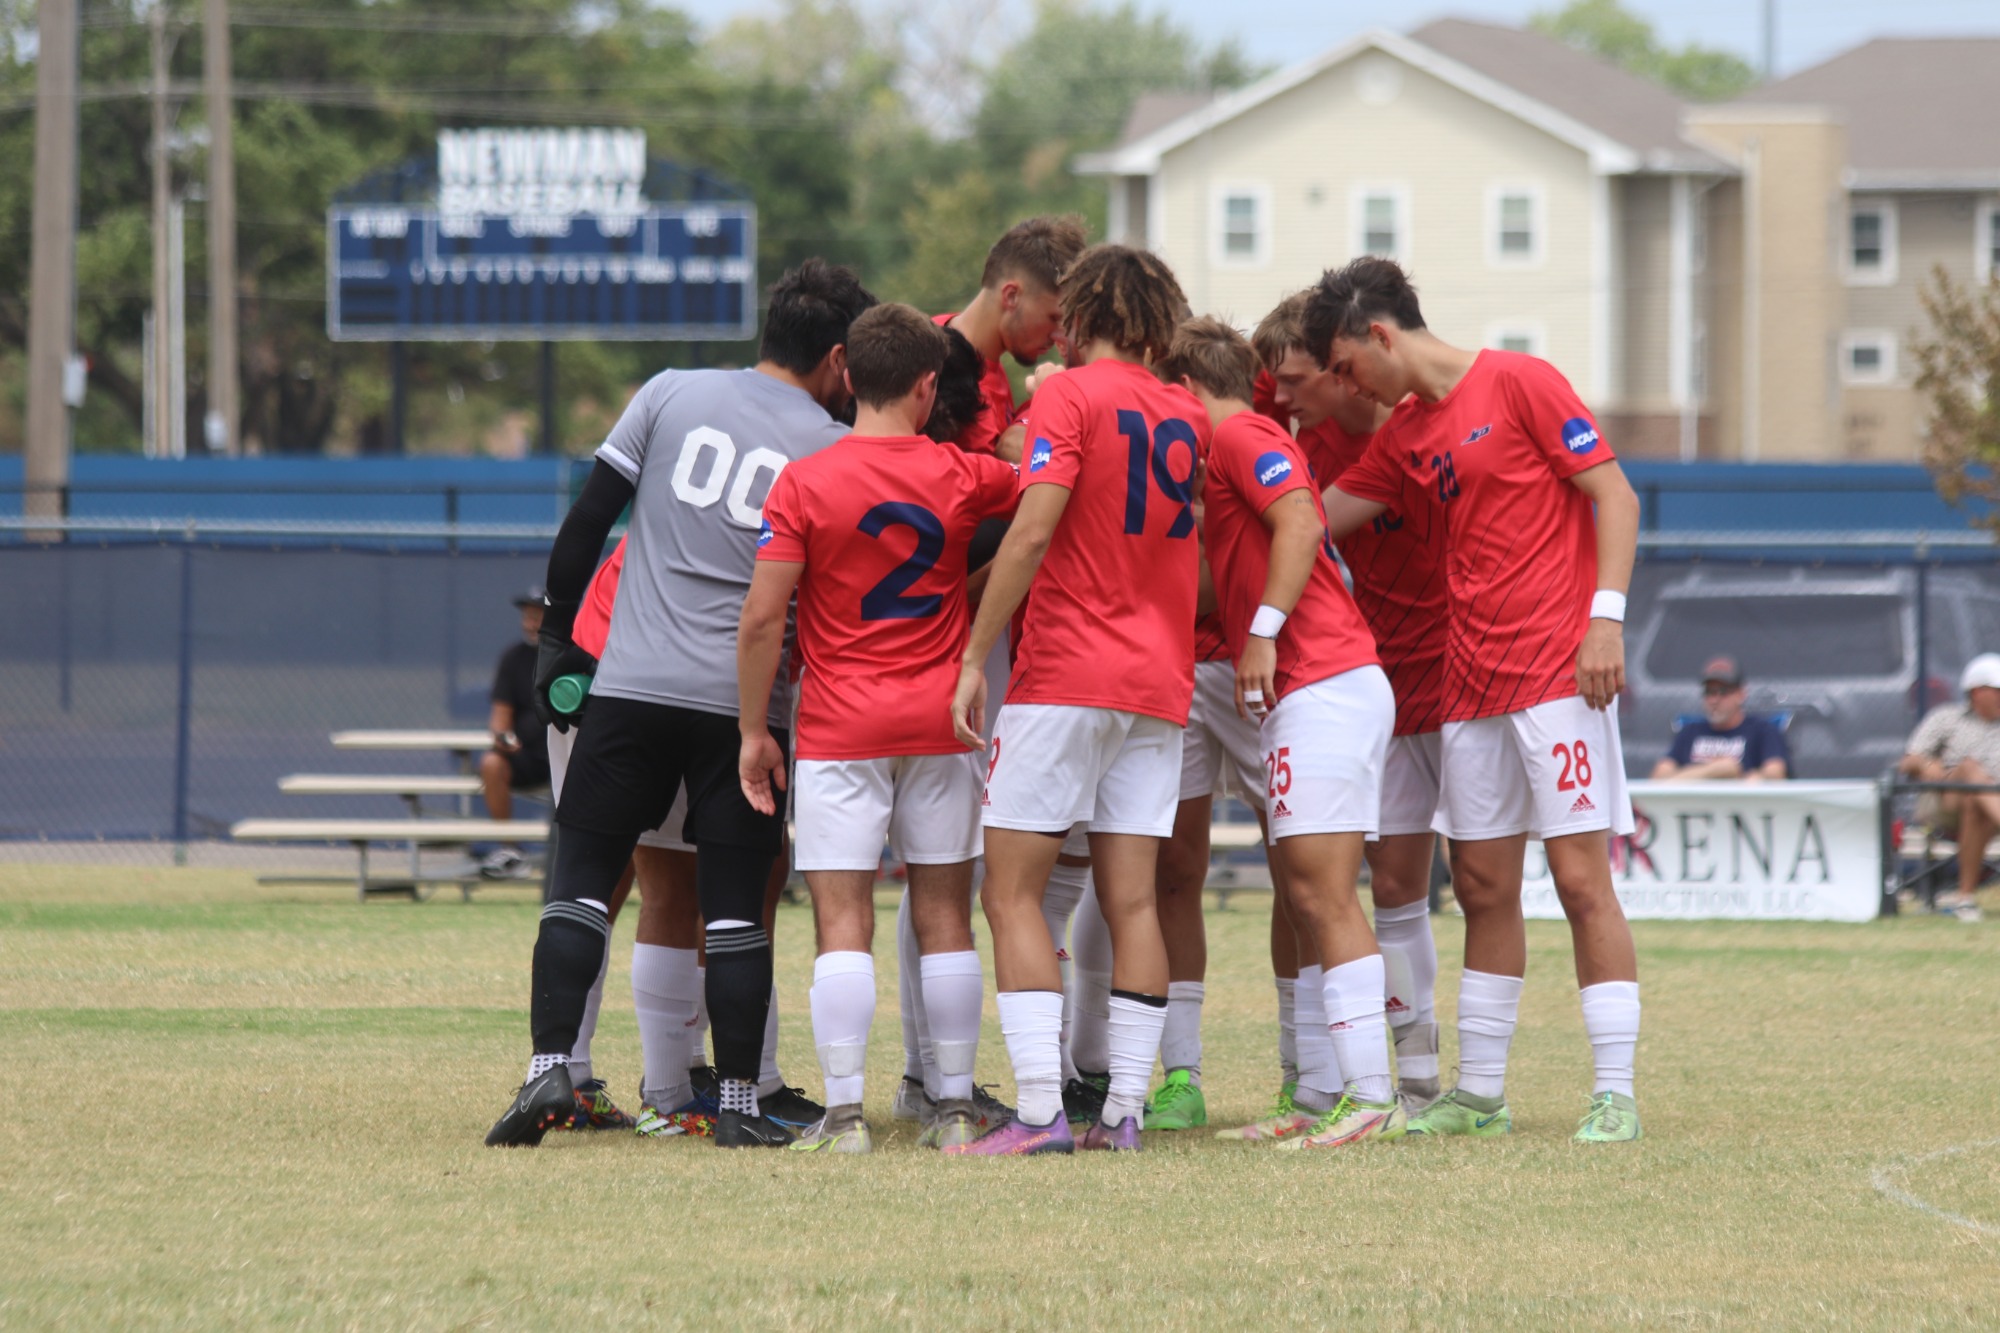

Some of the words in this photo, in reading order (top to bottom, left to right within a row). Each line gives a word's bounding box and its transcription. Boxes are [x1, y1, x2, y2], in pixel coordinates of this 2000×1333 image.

[438, 127, 647, 185] NEWMAN
[439, 183, 647, 215] BASEBALL
[1567, 429, 1599, 451] NCAA
[670, 425, 790, 530] 00
[1116, 408, 1198, 540] 19
[1260, 460, 1293, 485] NCAA
[856, 500, 946, 621] 2
[1265, 746, 1292, 799] 25
[1551, 739, 1592, 793] 28
[1522, 808, 1832, 883] RENA
